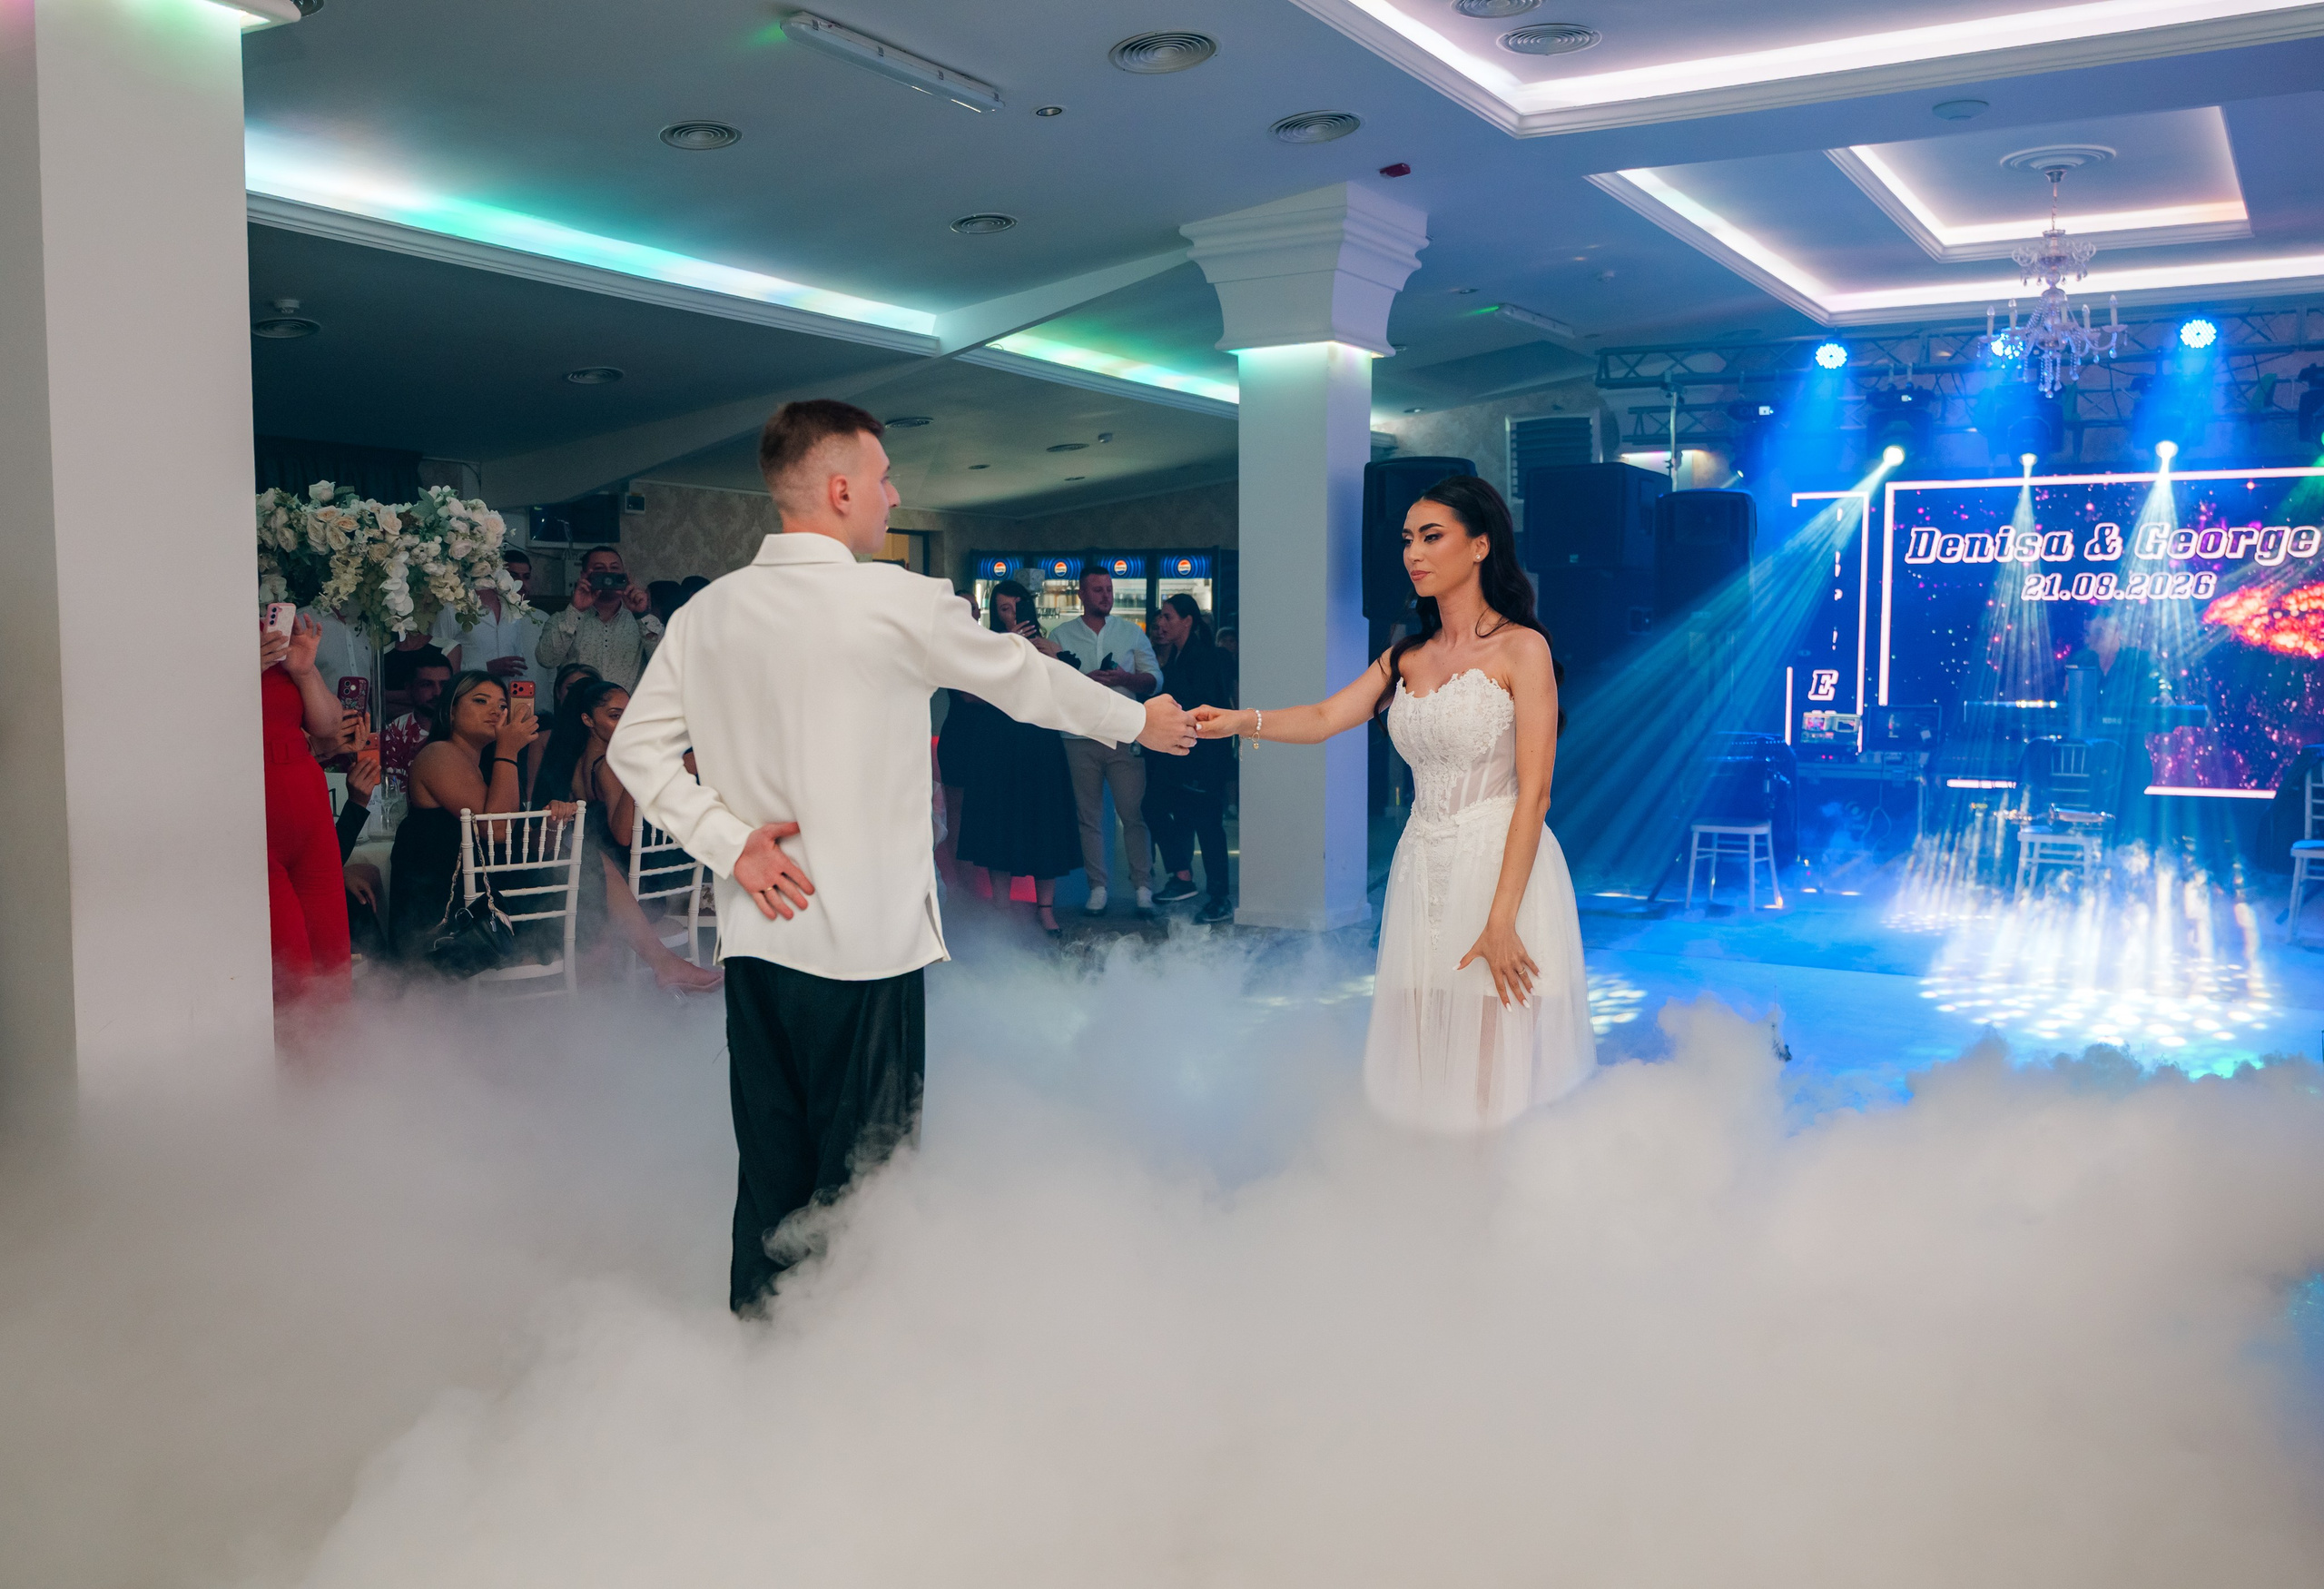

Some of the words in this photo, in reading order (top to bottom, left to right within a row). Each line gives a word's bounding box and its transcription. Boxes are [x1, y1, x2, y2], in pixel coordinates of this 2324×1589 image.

[1905, 525, 2074, 564] Denisa
[2083, 522, 2123, 561] &
[2134, 521, 2322, 567] George
[2021, 570, 2218, 601] 21.08.2026
